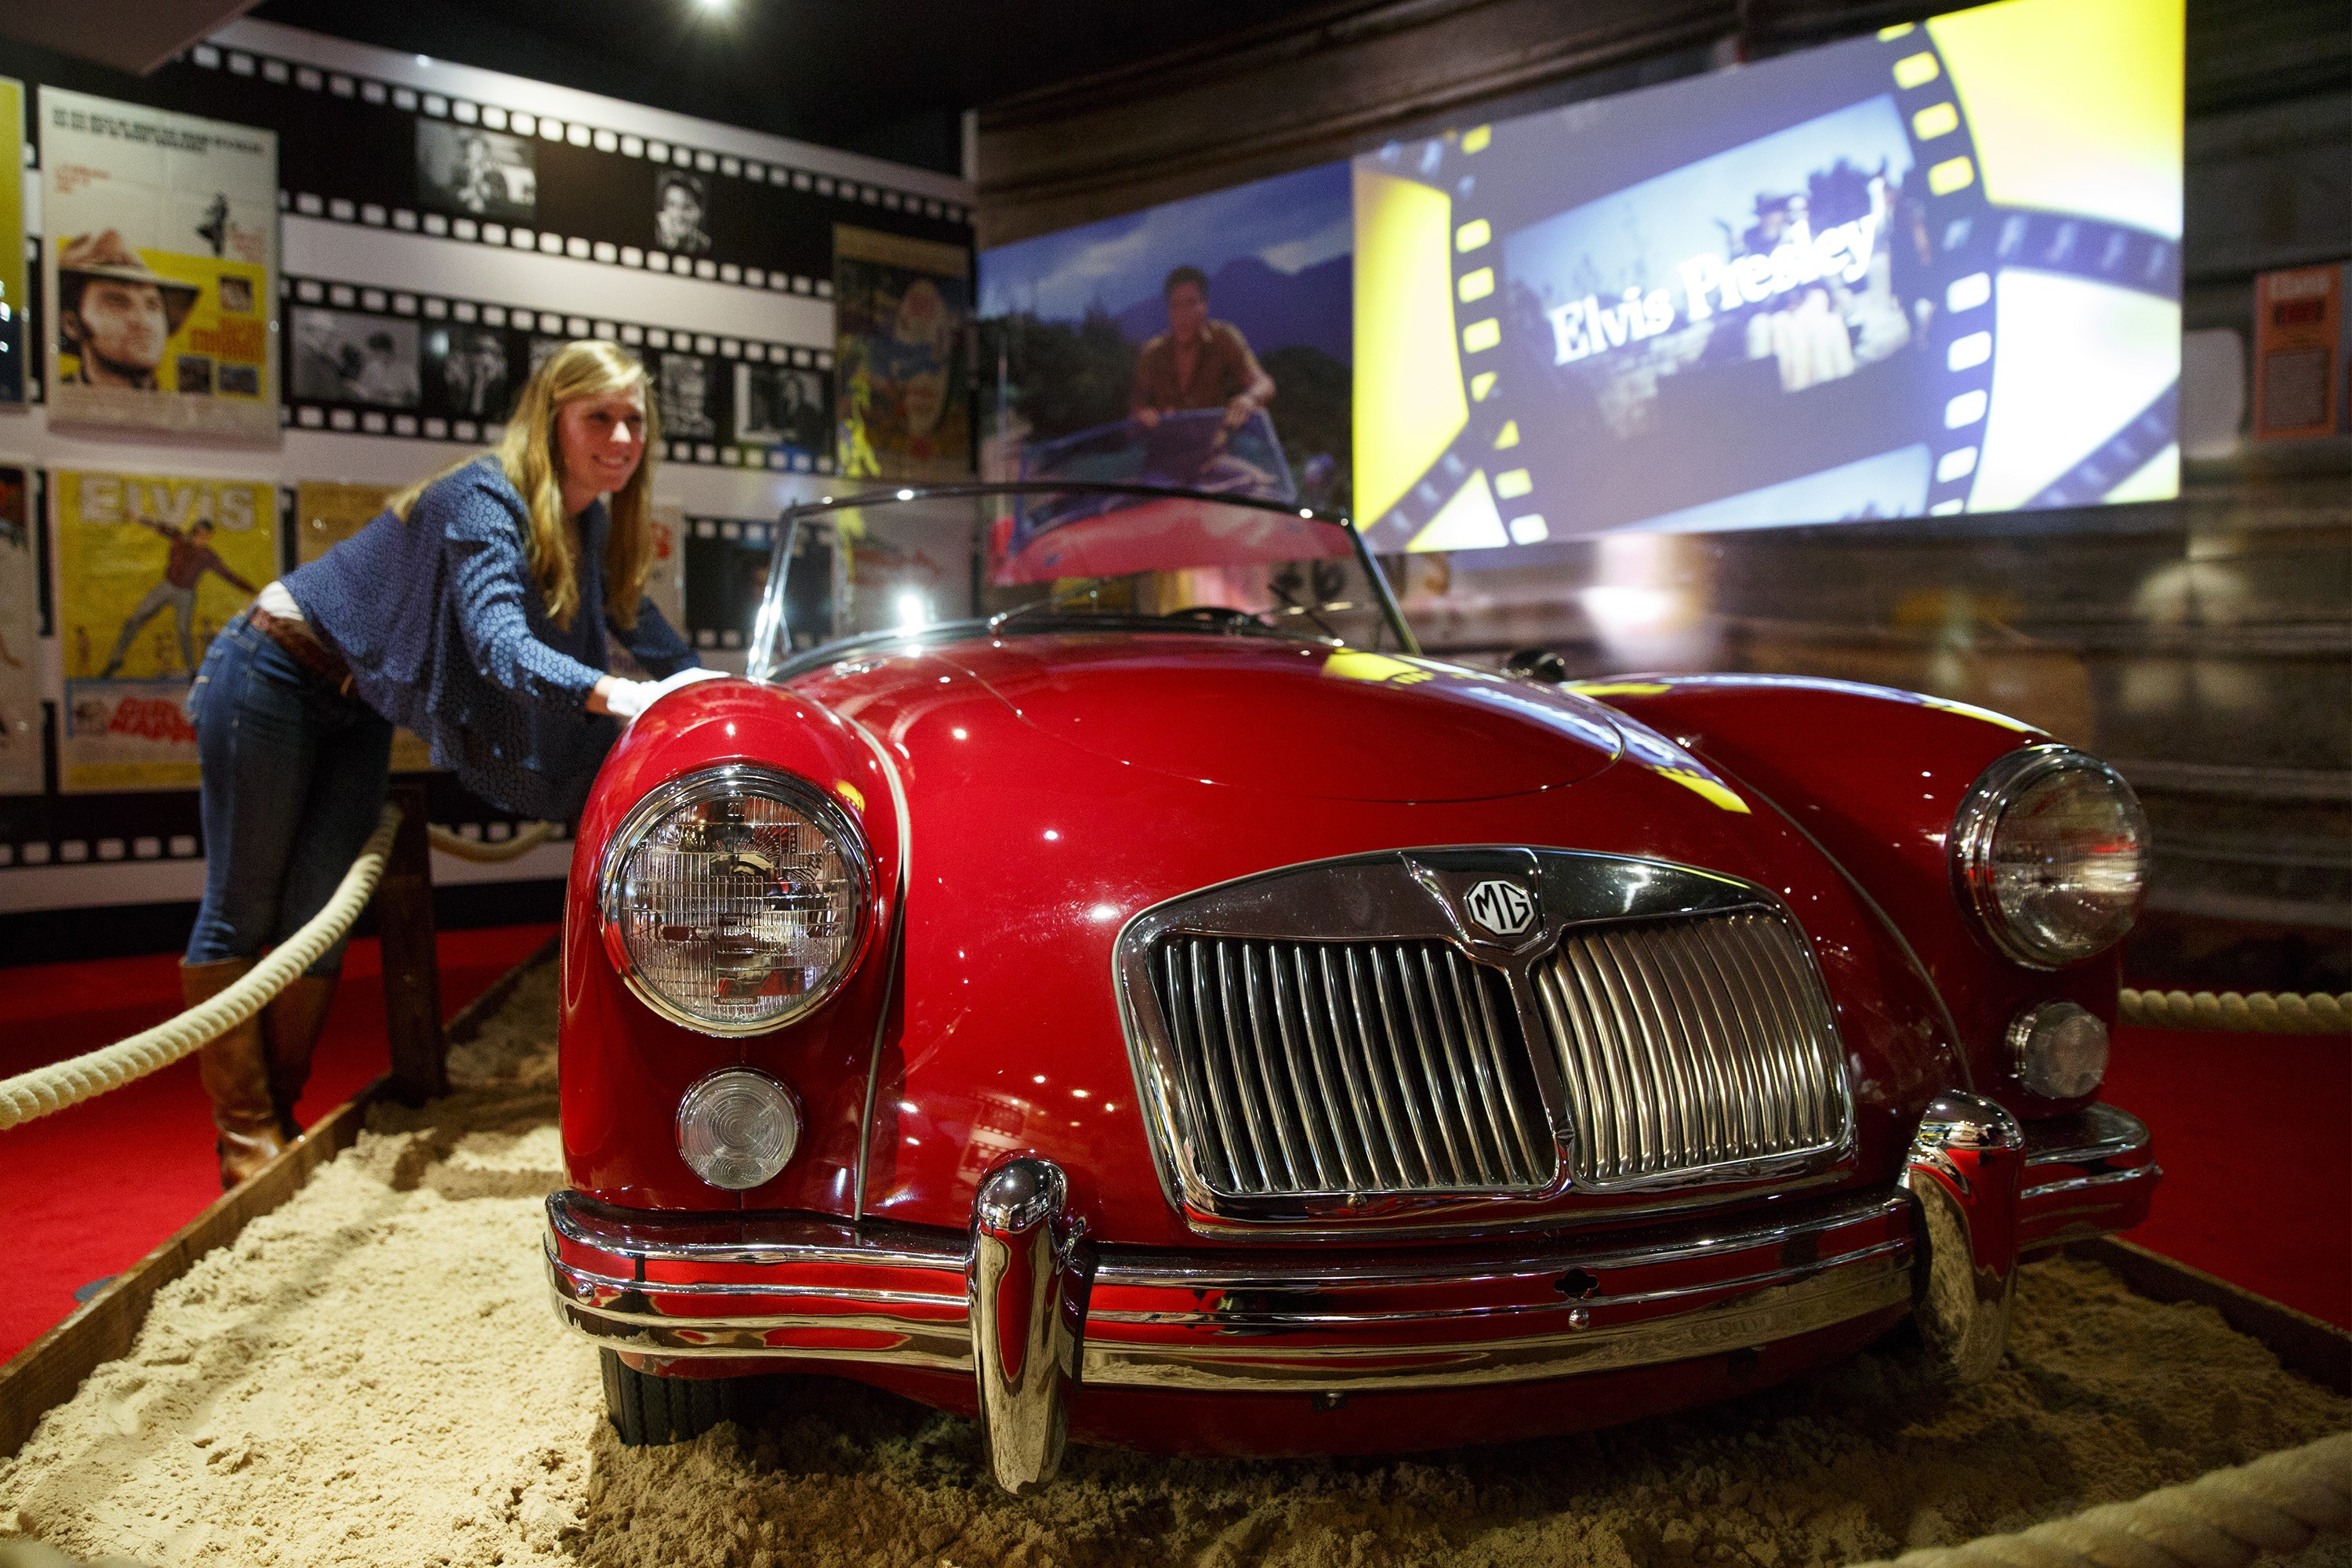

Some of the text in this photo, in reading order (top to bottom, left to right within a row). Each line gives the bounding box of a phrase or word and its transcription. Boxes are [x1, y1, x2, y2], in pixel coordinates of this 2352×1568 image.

[1551, 214, 1878, 365] Elvis Presley
[1474, 884, 1530, 930] MG
